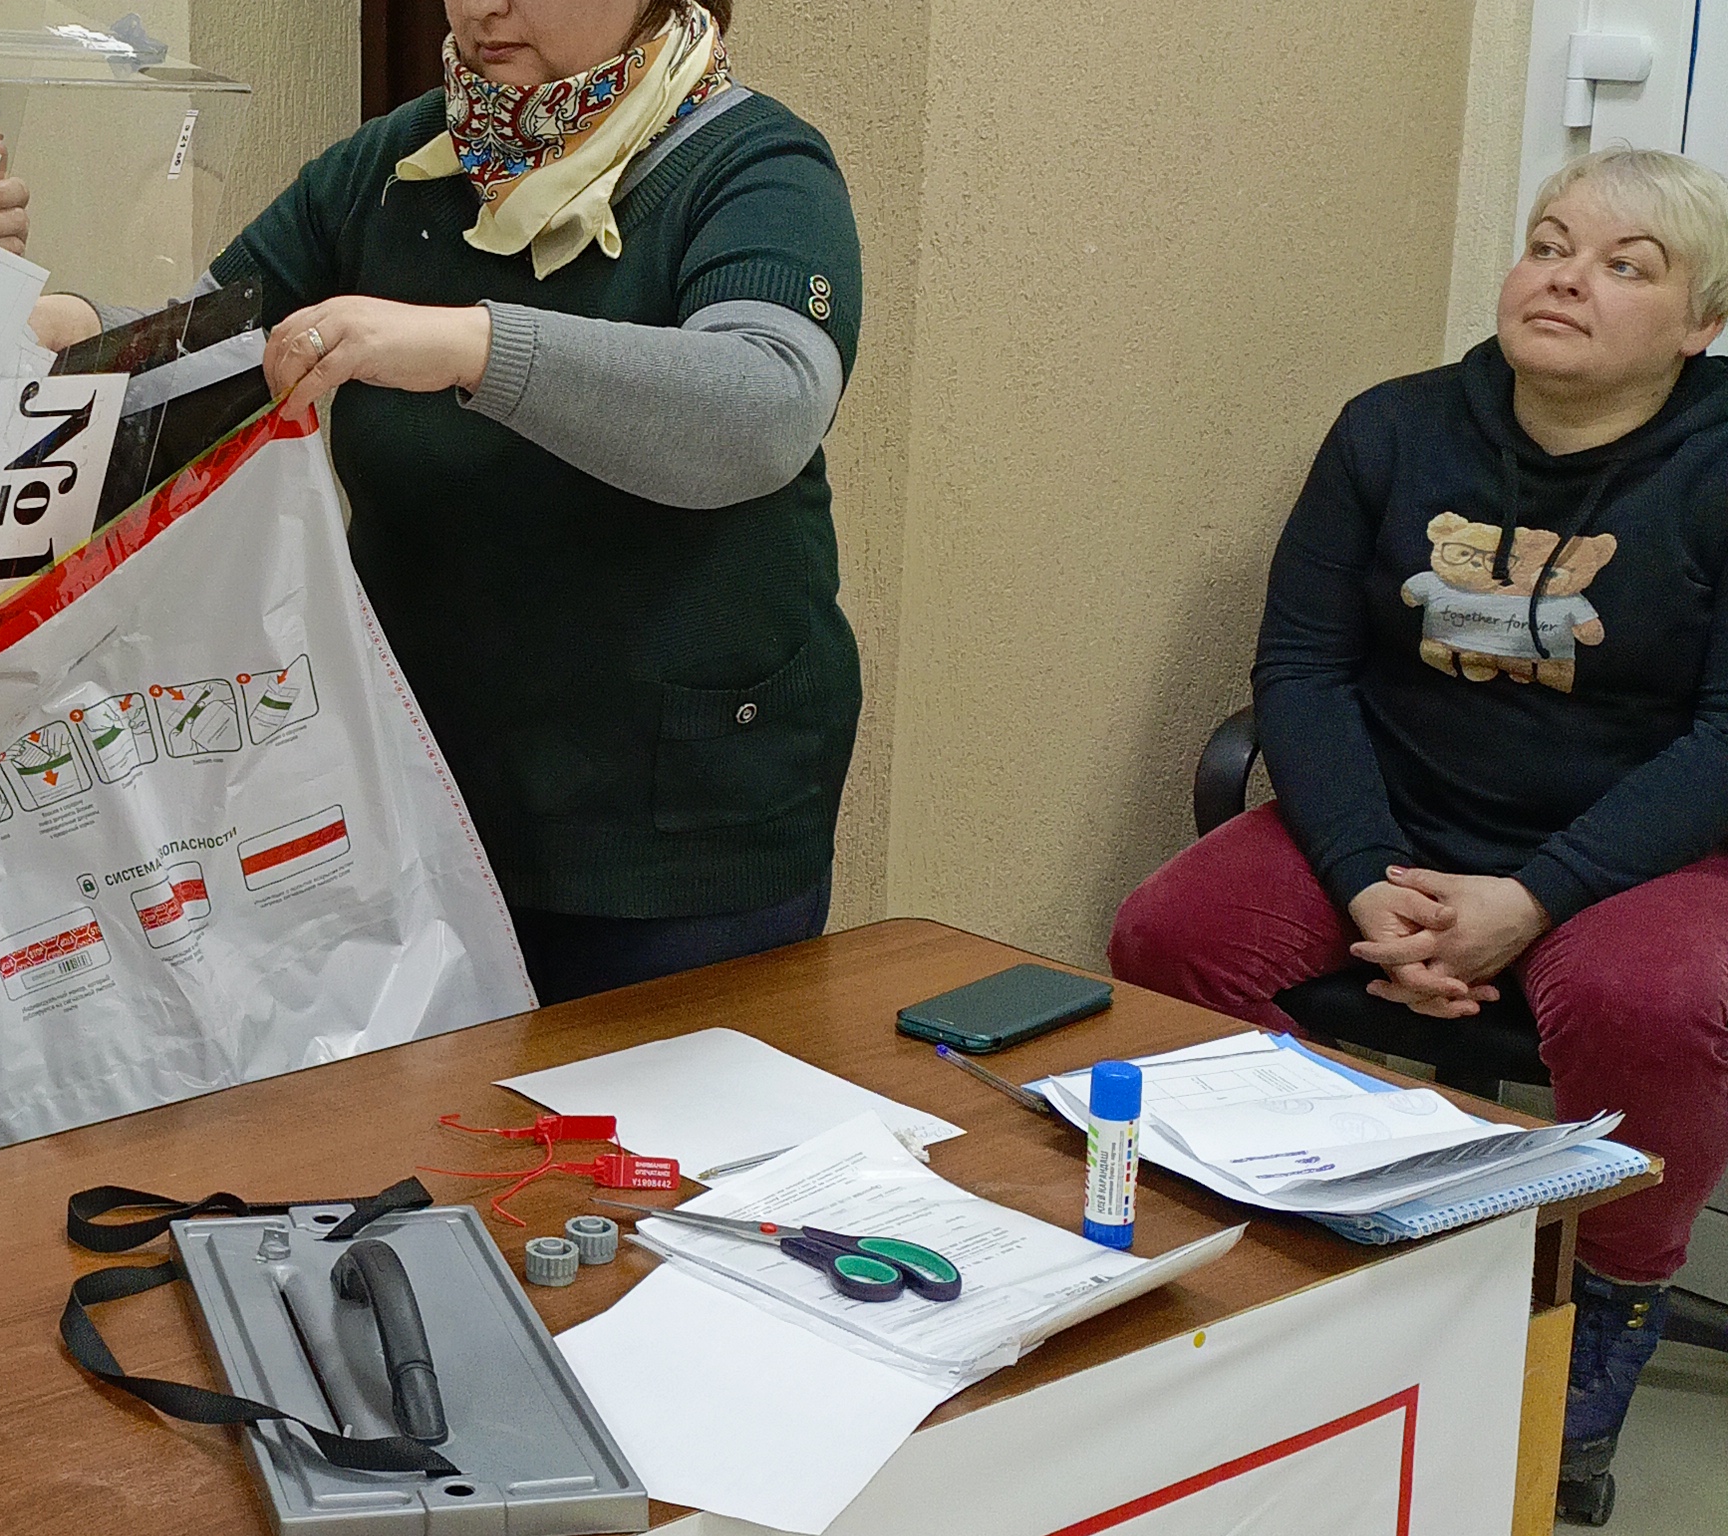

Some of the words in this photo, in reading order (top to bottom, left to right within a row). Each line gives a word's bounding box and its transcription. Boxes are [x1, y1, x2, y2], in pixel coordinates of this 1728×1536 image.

[1440, 605, 1500, 627] together
[1504, 615, 1559, 633] forver
[104, 857, 161, 888] СИСТЕМА
[1098, 1150, 1108, 1193] КАРАНДАШ
[1097, 1194, 1106, 1213] КЛЕЙ
